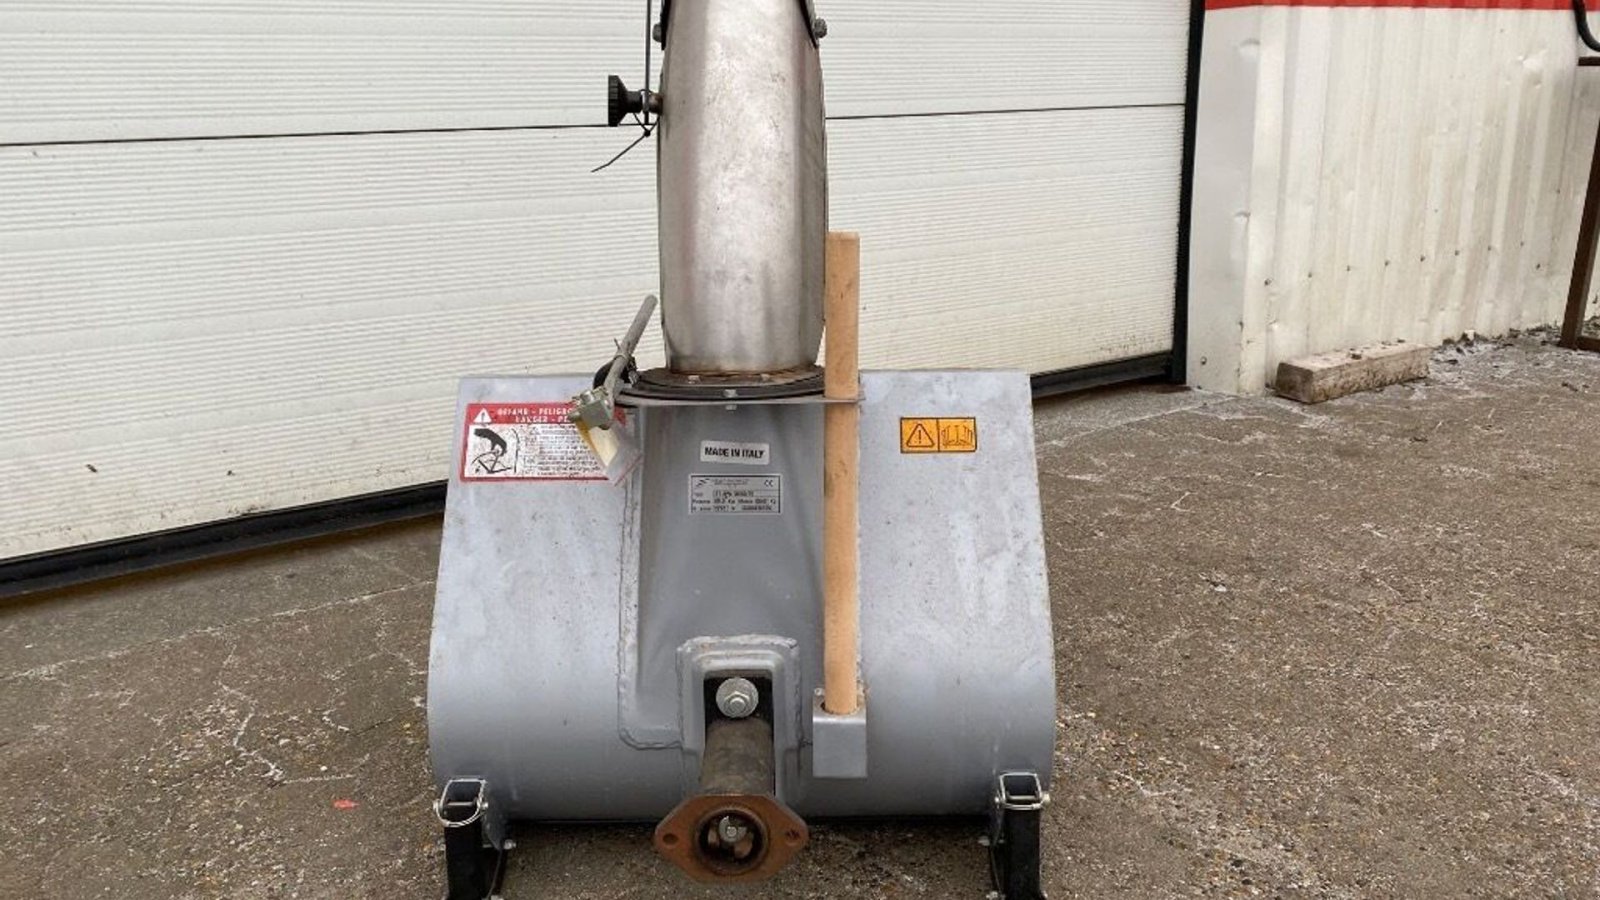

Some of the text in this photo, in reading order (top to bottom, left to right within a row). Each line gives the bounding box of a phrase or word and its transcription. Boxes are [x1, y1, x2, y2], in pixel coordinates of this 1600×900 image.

[704, 447, 765, 458] MADE IN ITALY
